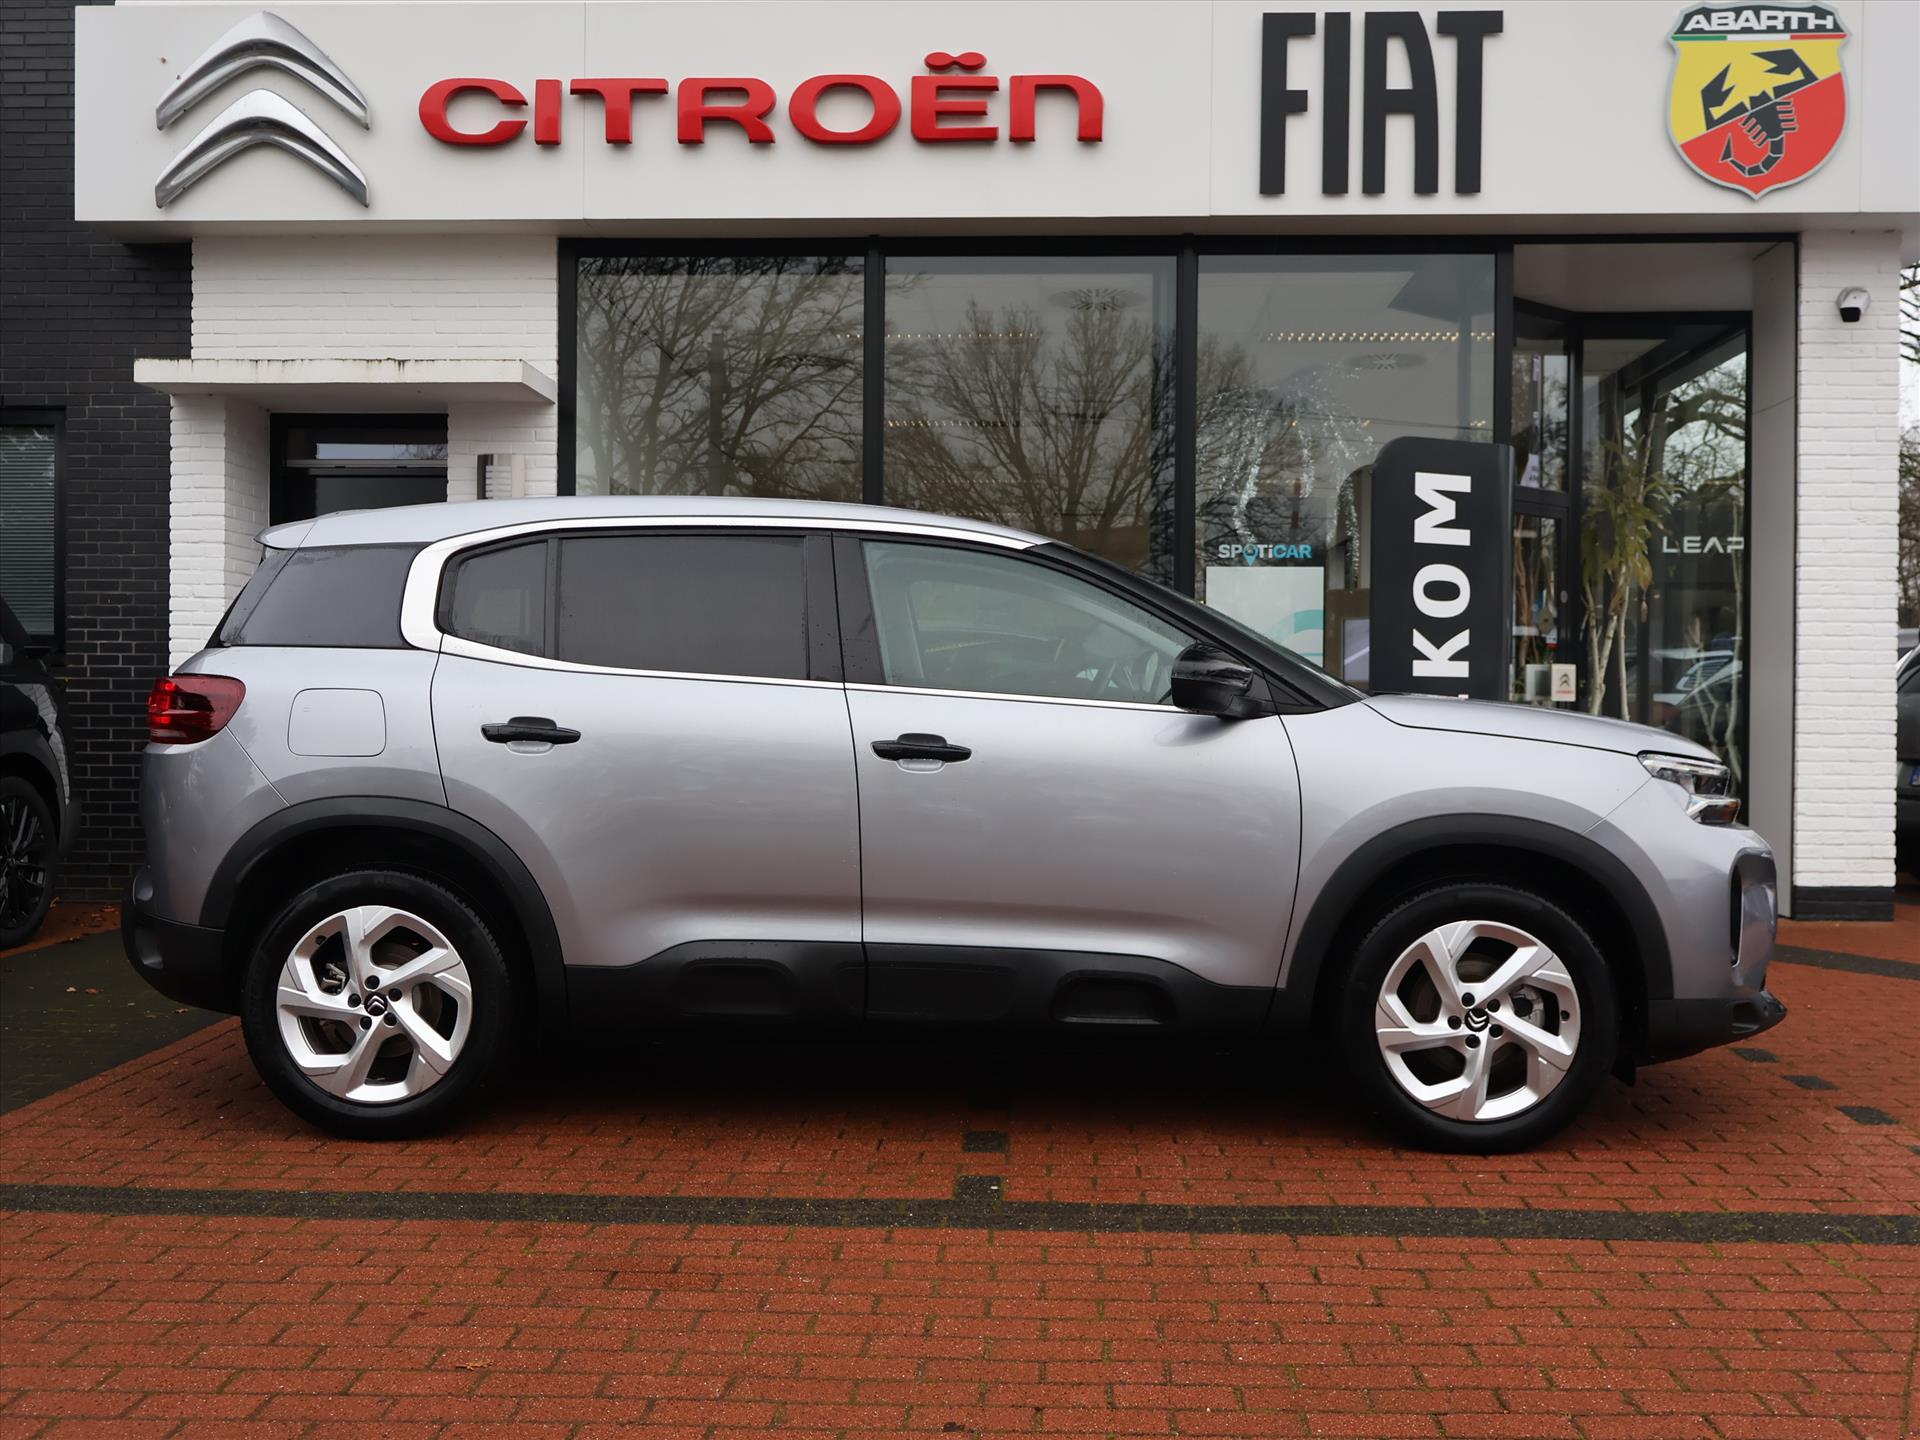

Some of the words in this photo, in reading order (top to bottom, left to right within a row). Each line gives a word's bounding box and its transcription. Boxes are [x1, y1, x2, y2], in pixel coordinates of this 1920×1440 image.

[1683, 9, 1835, 31] ABARTH
[418, 51, 1104, 147] CITROËN
[1259, 10, 1504, 195] FIAT
[1412, 471, 1472, 699] KOM
